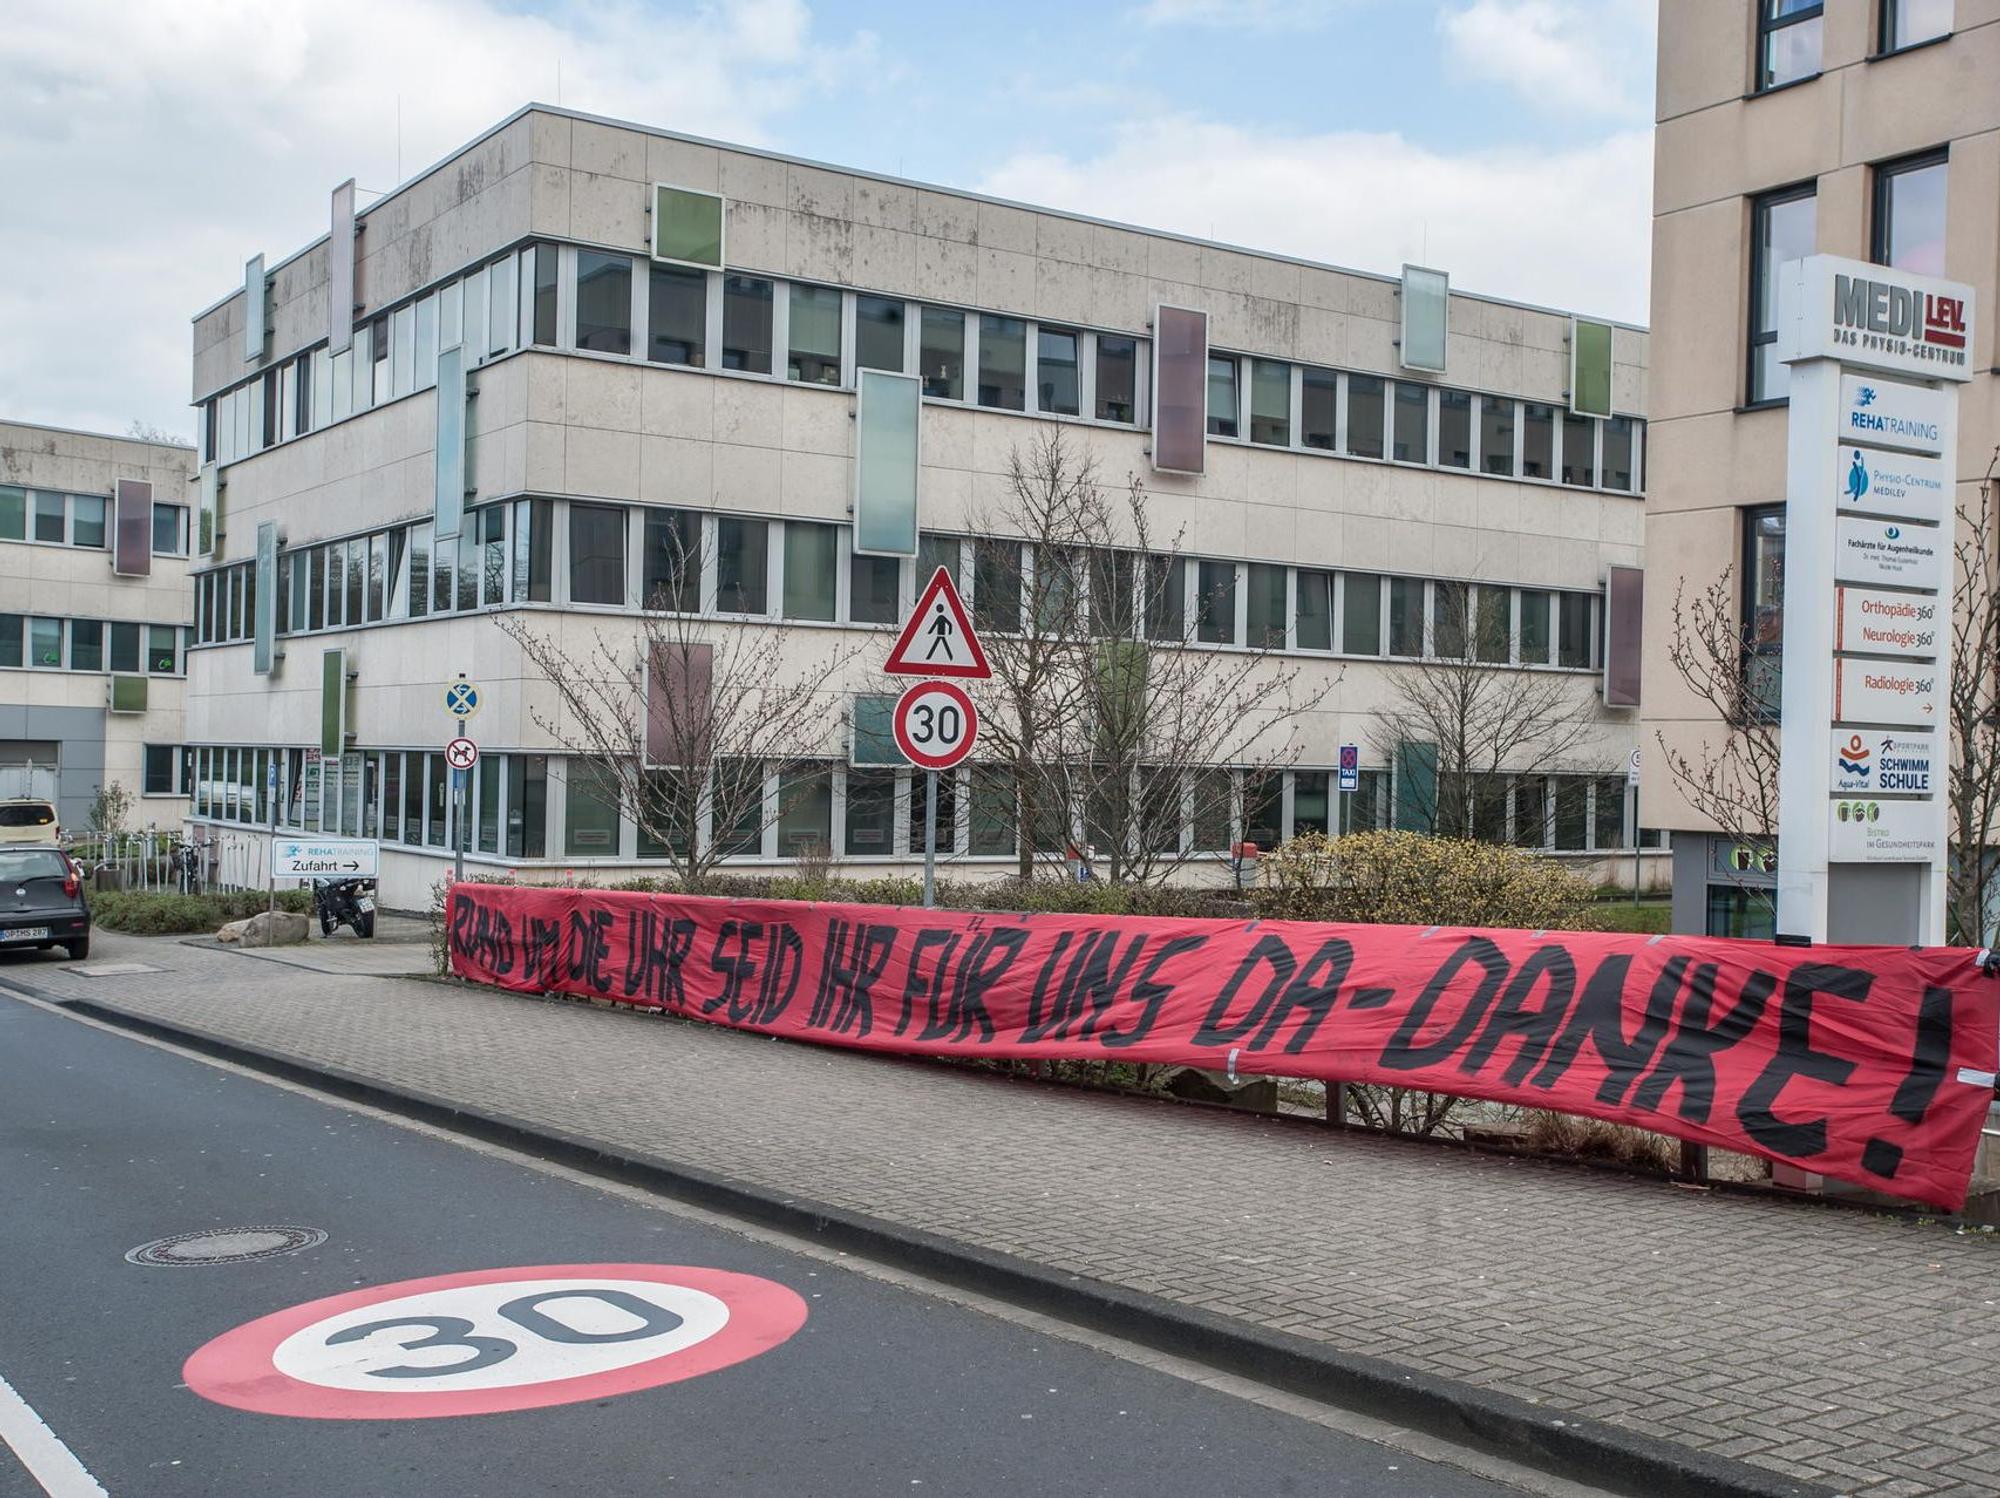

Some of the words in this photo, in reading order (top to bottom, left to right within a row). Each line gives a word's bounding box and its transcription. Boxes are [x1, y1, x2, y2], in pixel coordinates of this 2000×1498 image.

[1834, 328, 1857, 346] DAS
[1862, 334, 1965, 366] PHYSIO-CENTRUM
[1852, 411, 1938, 440] REHATRAINING
[912, 704, 960, 744] 30
[1880, 758, 1929, 772] SCHWIMM
[1880, 773, 1929, 790] SCHULE
[292, 860, 338, 871] Zufahrt
[453, 893, 514, 975] RUND
[523, 913, 560, 985] UM
[568, 909, 613, 993] DIE
[624, 910, 699, 1006] UHR
[702, 920, 804, 1025] SEID
[806, 918, 898, 1038] IHR
[895, 917, 1032, 1044] FÜR
[1017, 928, 1209, 1048] UNS
[325, 1289, 685, 1378] 30
